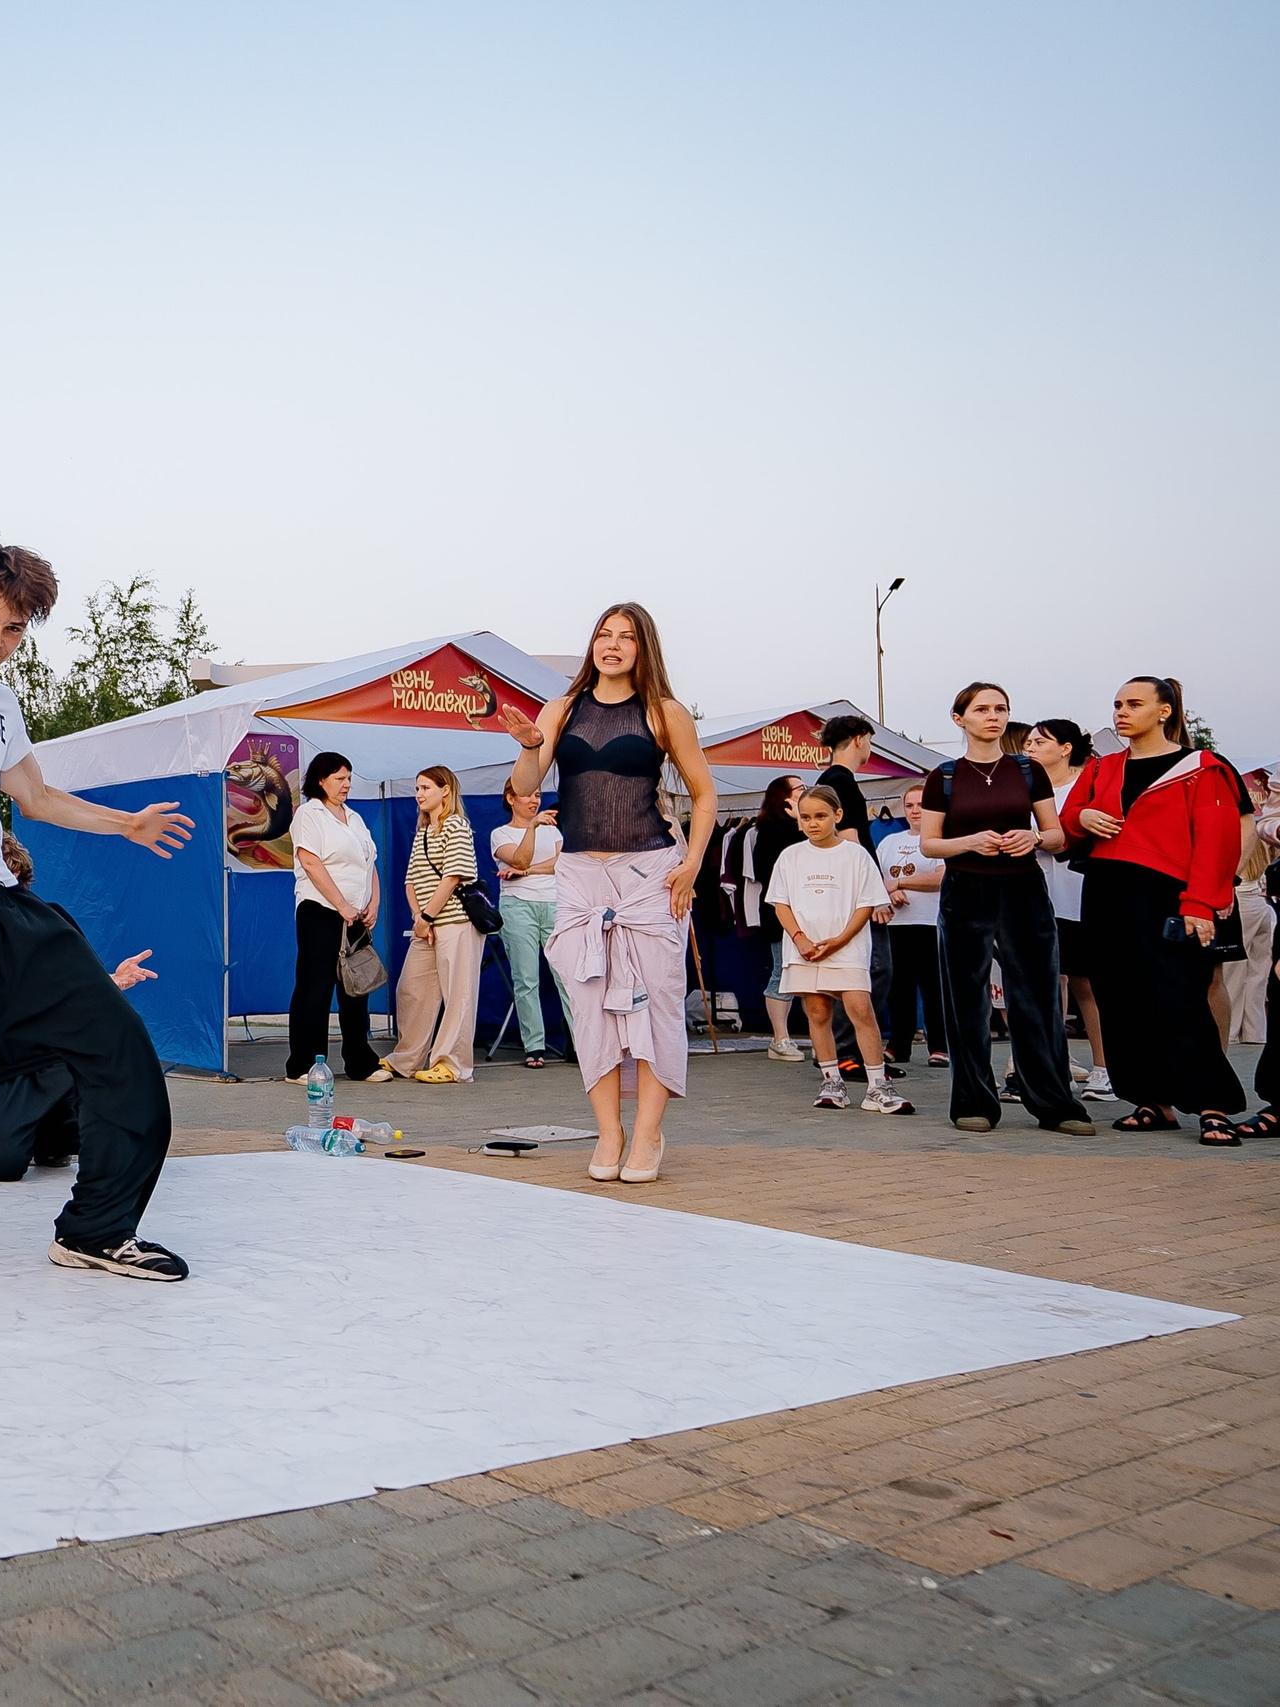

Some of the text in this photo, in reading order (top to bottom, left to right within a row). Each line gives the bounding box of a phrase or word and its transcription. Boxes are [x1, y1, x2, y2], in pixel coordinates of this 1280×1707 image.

[390, 669, 435, 691] ДЕНЬ
[392, 688, 477, 715] МОЛОДЁЖИ
[761, 725, 793, 744] ДЕНЬ
[762, 742, 823, 764] МОЛОДЁЖИ
